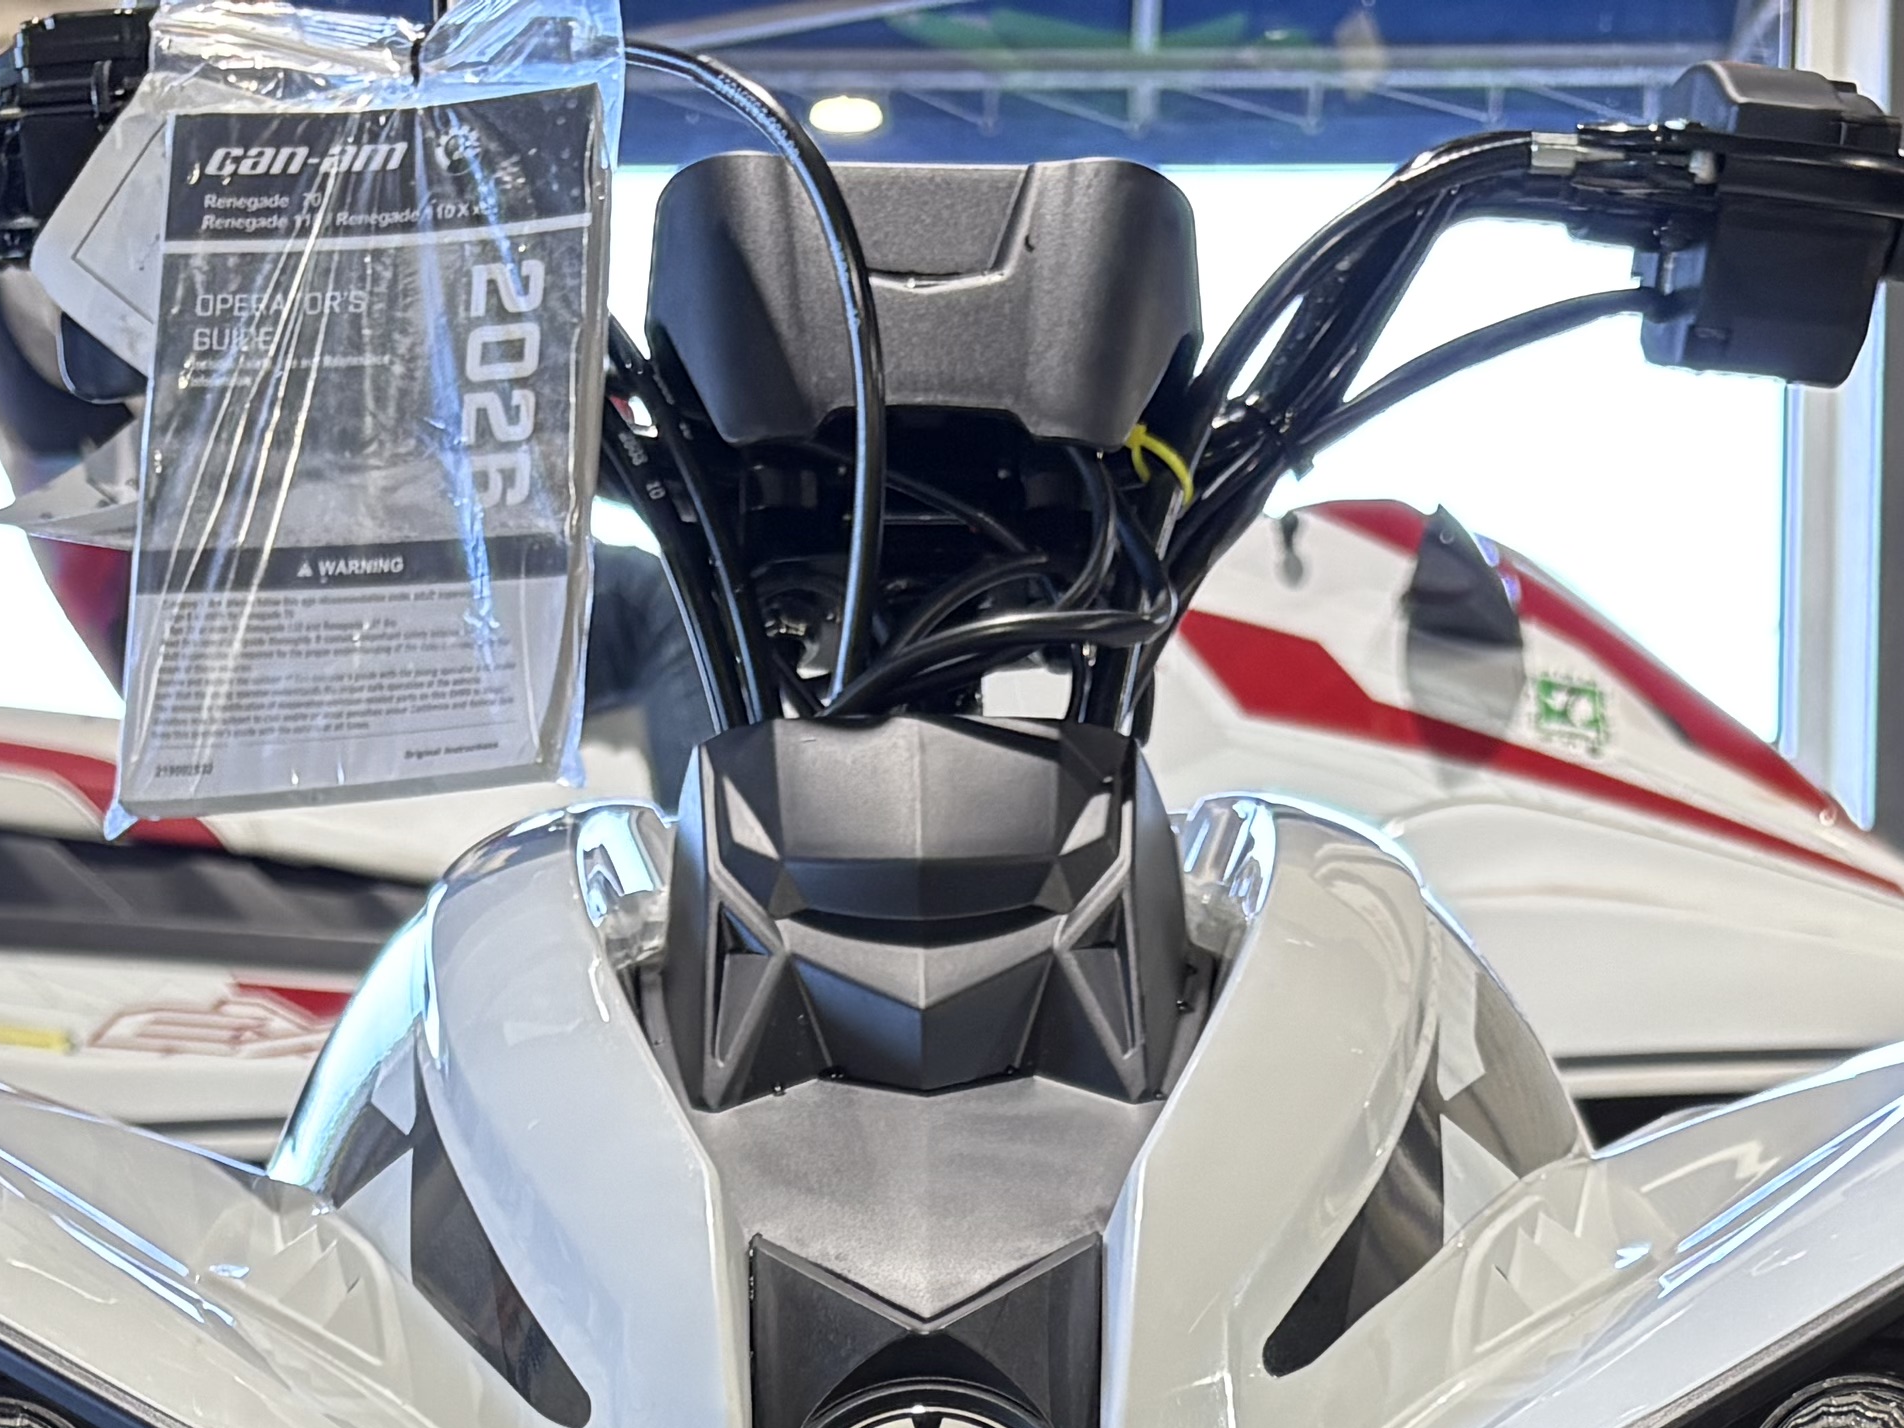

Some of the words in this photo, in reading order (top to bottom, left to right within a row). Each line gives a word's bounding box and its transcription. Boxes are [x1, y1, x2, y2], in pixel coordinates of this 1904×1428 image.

[204, 141, 410, 176] can-am
[203, 193, 289, 212] Renegade
[201, 214, 289, 231] Renegade
[335, 208, 420, 227] Renegade
[196, 290, 368, 317] OPERAOR'S
[193, 326, 274, 351] GUIE
[459, 259, 545, 508] 2026
[318, 556, 404, 576] WARNING
